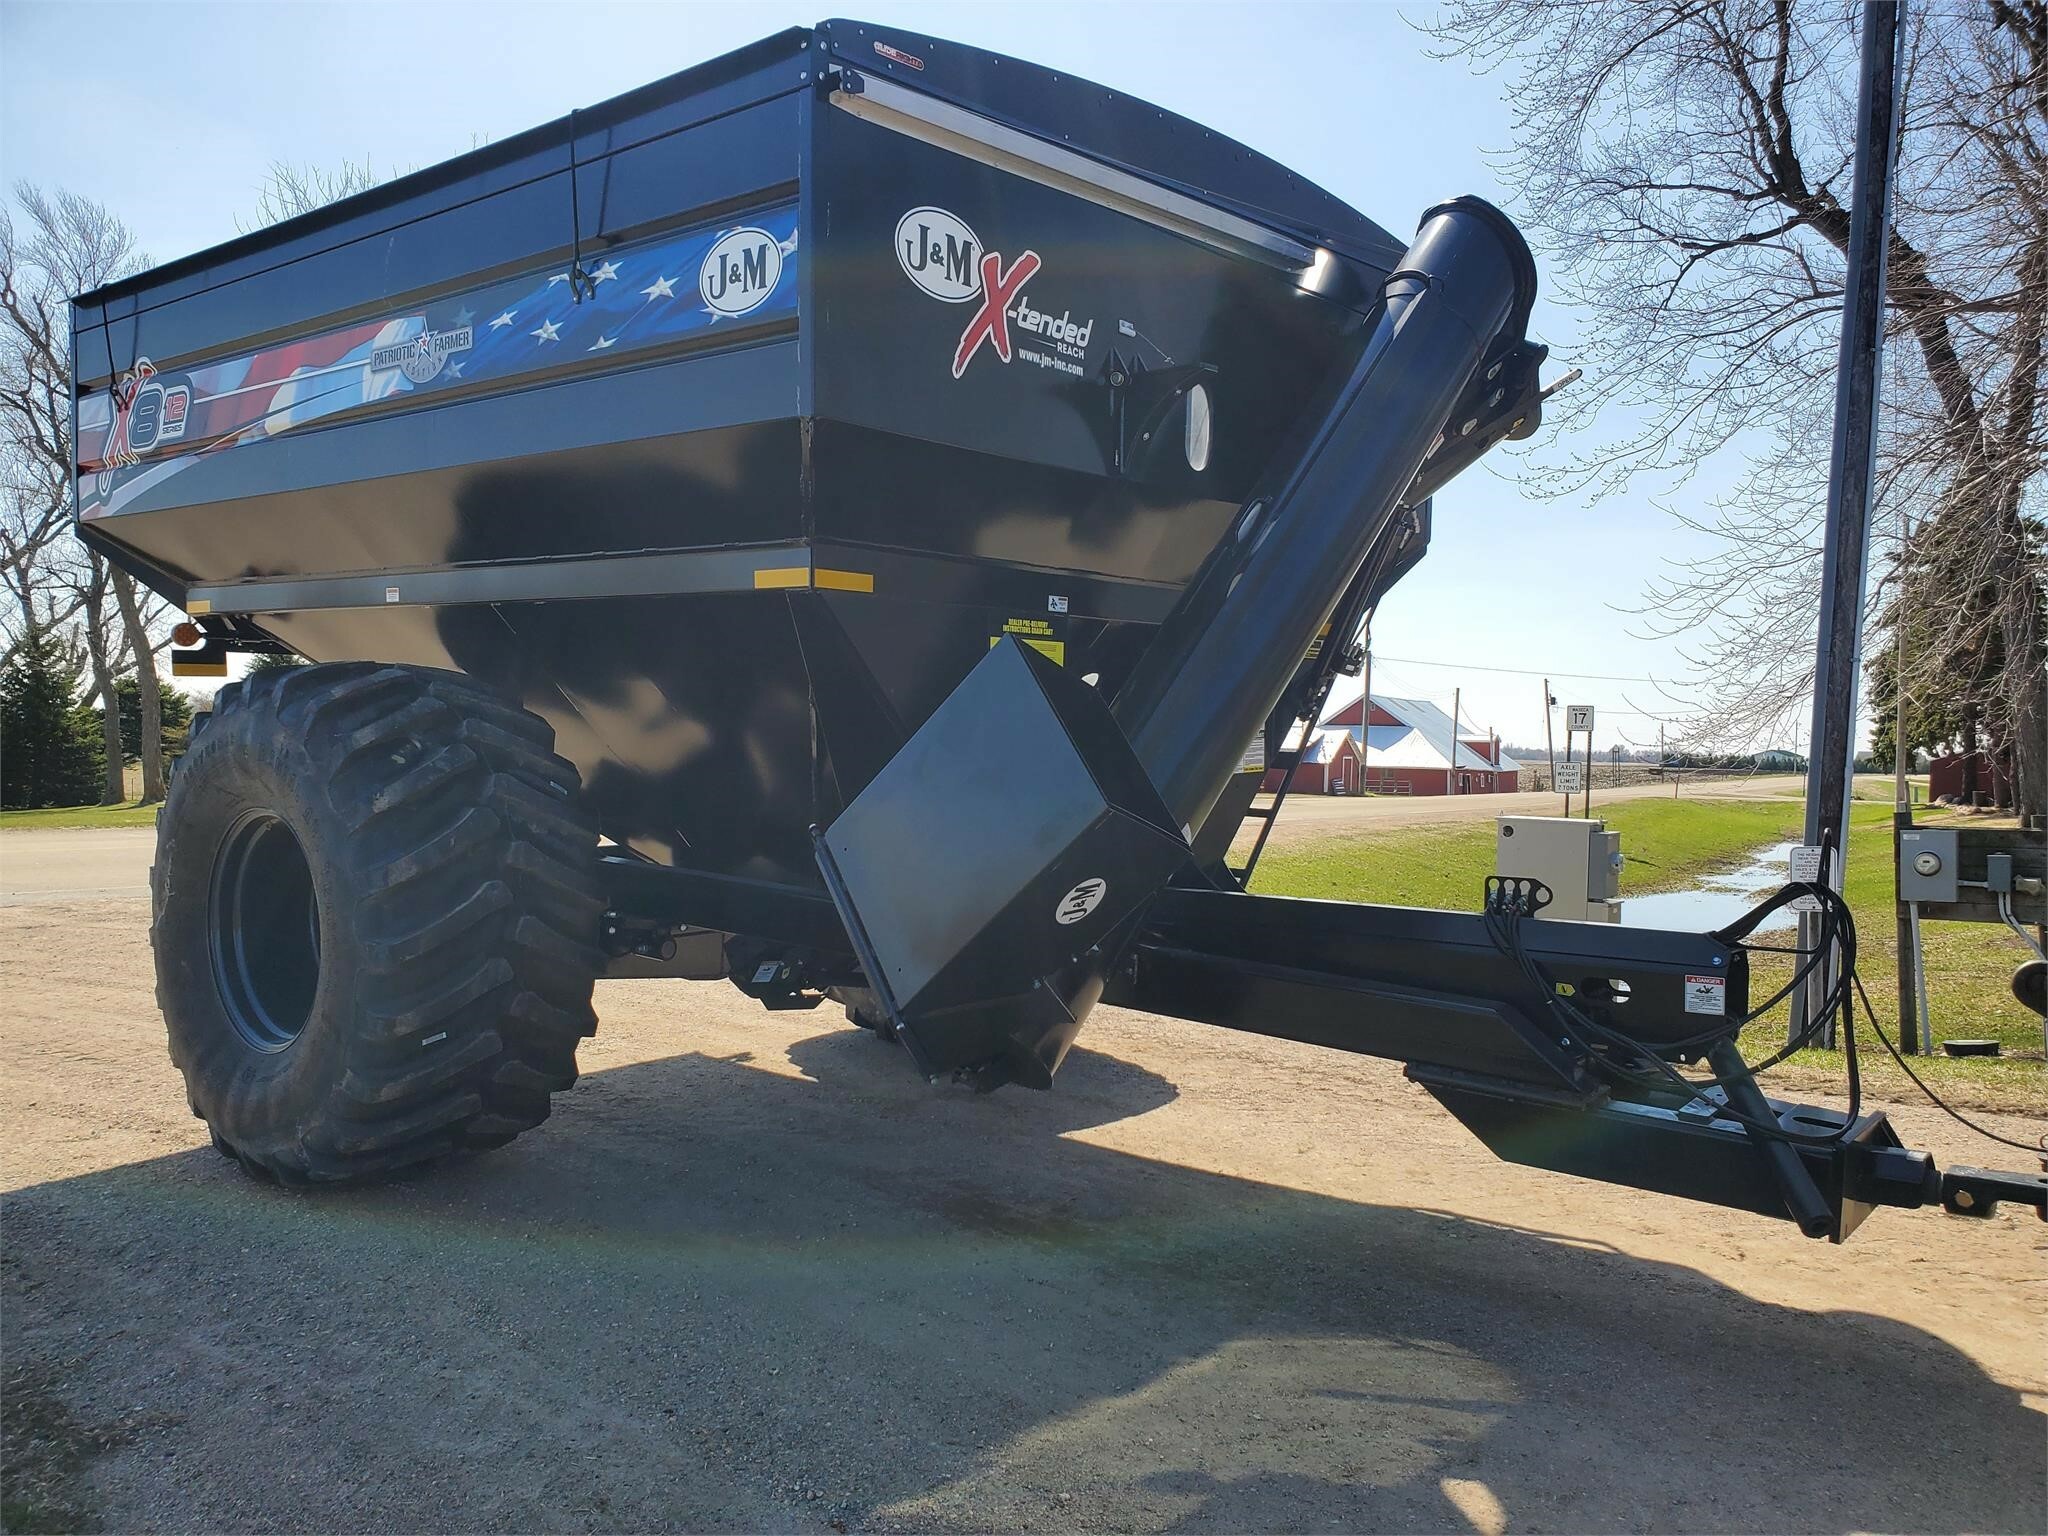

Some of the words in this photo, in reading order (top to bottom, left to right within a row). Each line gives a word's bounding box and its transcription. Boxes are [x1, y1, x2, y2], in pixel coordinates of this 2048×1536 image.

[905, 223, 974, 288] J&M
[707, 243, 768, 300] J&M
[374, 344, 416, 366] PATRIOTIC
[434, 330, 470, 352] FARMER
[1057, 341, 1085, 360] REACH
[405, 357, 442, 377] EDITION
[1018, 348, 1084, 377] www.jm-inc.com
[162, 424, 183, 435] SERIES
[1573, 712, 1588, 725] 17
[1061, 881, 1103, 922] J&M
[1696, 977, 1721, 985] DANGER
